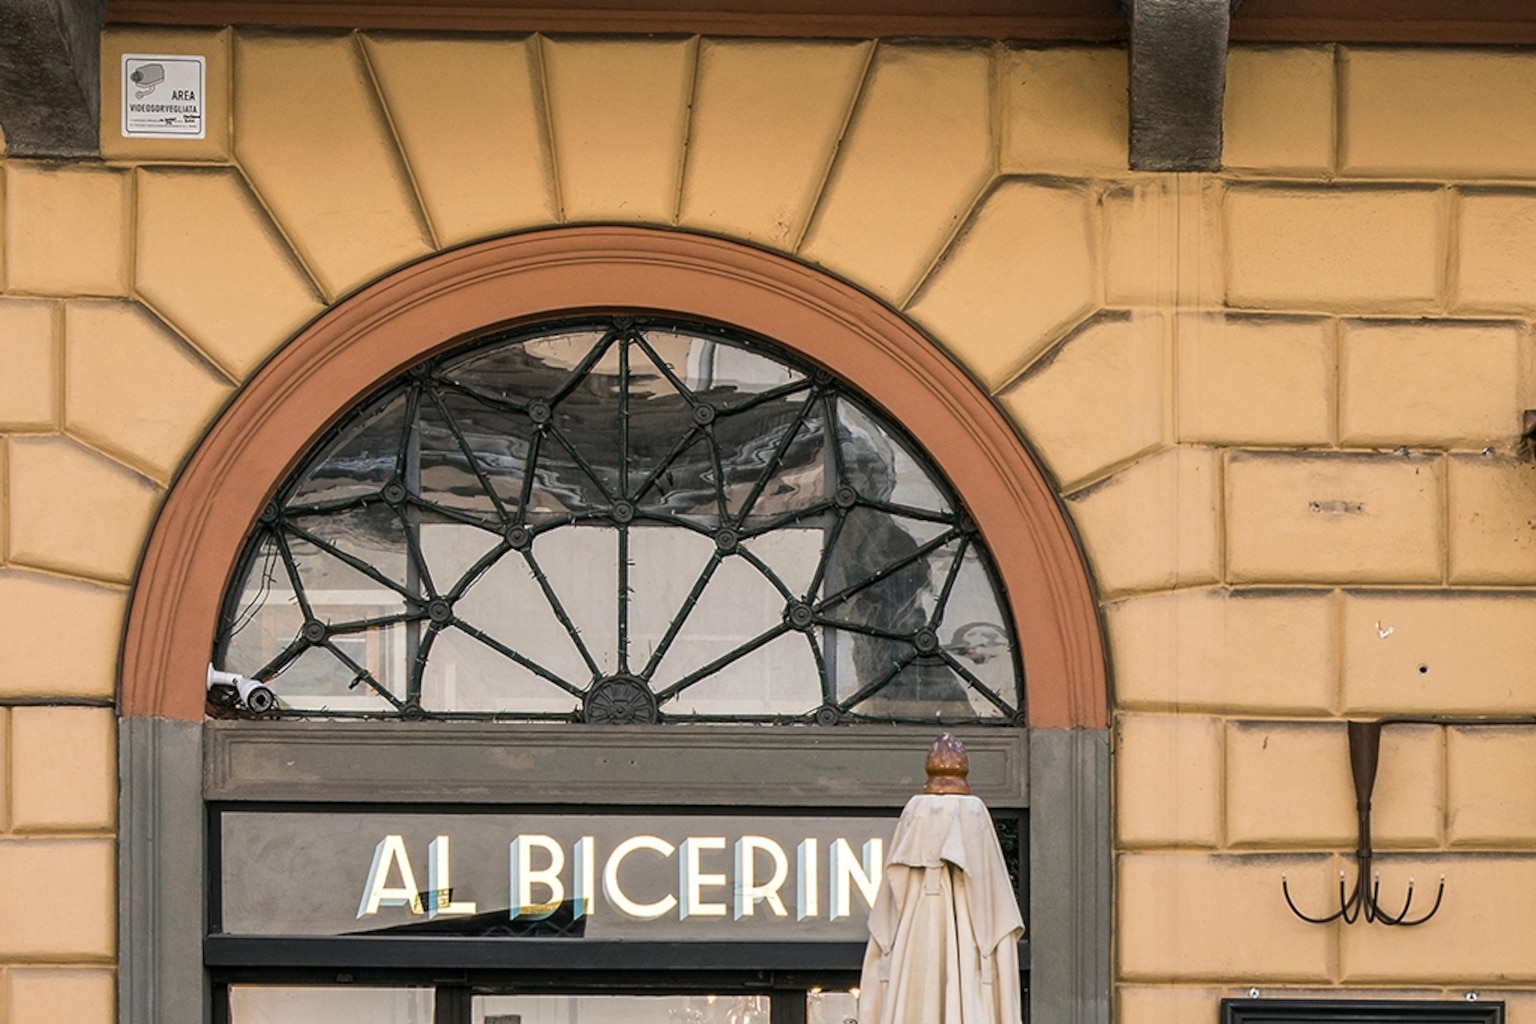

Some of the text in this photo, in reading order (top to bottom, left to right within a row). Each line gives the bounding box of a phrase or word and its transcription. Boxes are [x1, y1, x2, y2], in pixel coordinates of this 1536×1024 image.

[171, 90, 196, 101] AREA
[129, 103, 198, 114] VIDEOSORVEGLIATA
[355, 834, 885, 921] AL BICERIN
